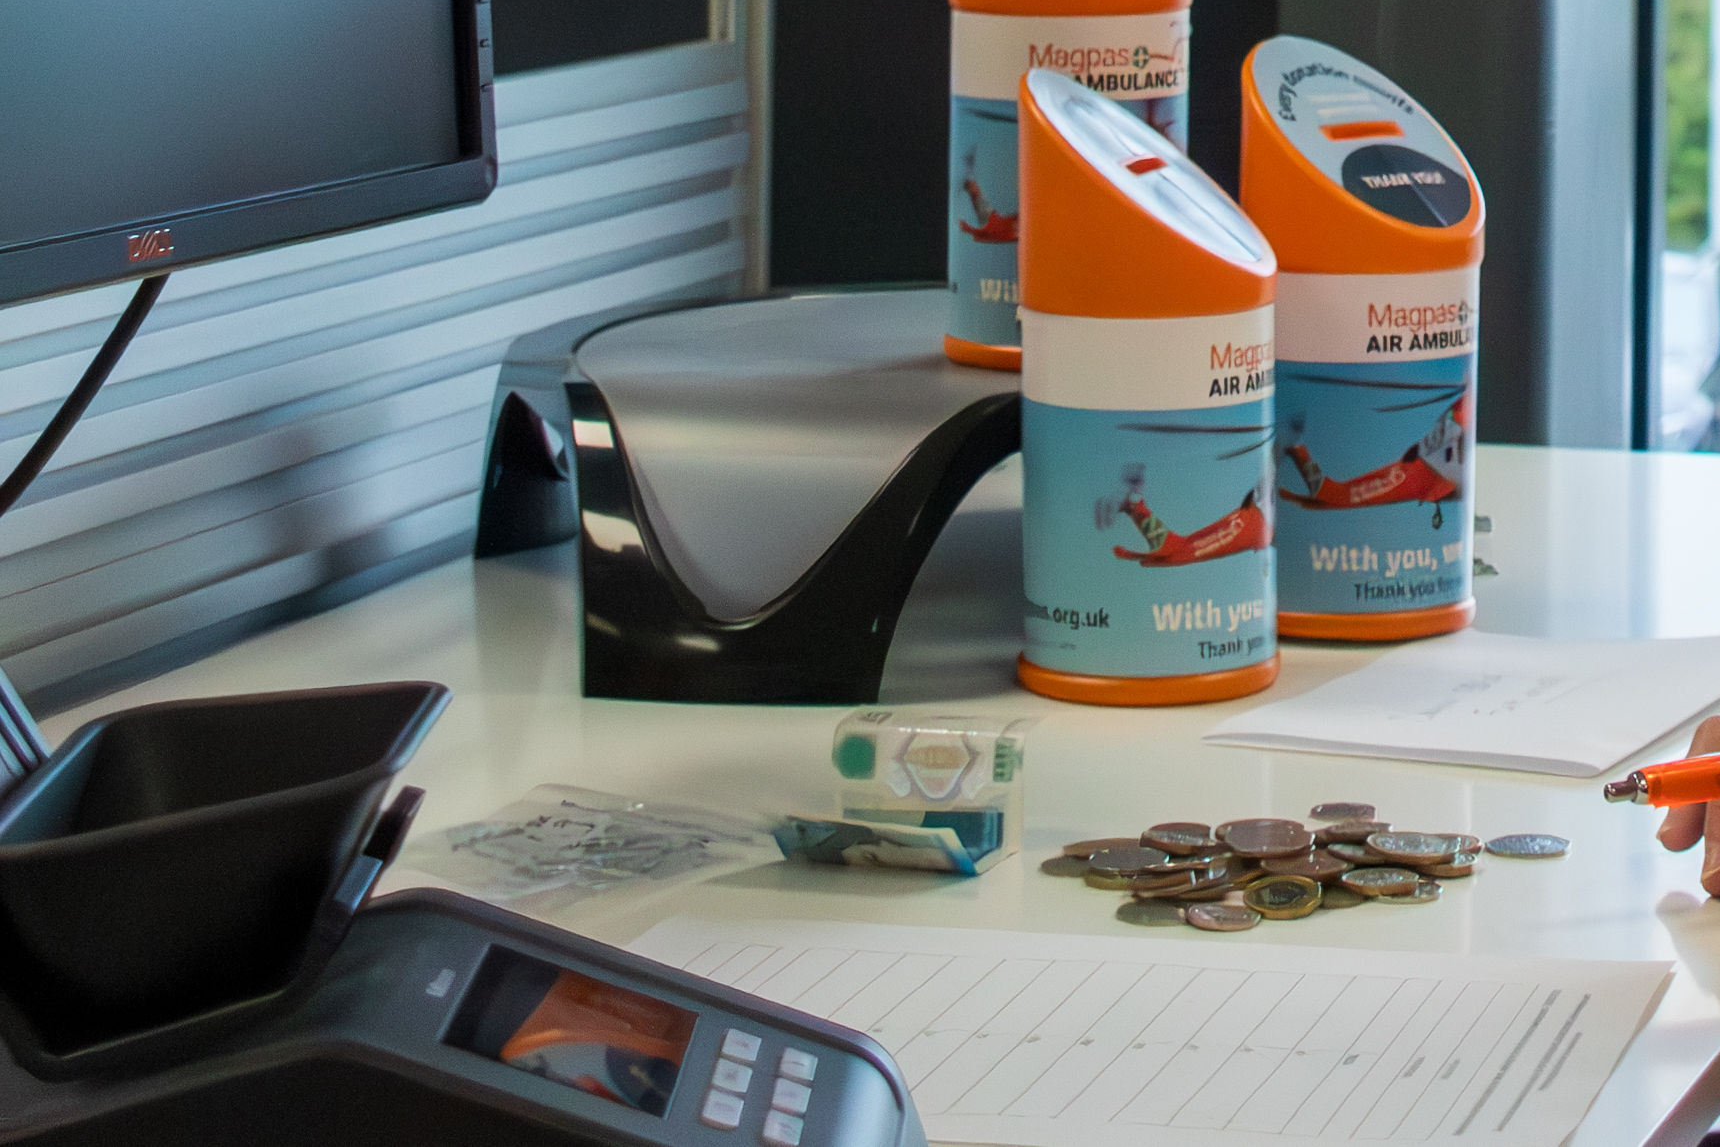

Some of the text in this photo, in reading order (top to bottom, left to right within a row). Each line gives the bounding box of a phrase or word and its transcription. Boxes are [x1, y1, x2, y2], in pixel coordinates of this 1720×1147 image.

[1028, 42, 1130, 74] Magpas
[1367, 302, 1457, 334] Magpas
[1366, 335, 1402, 353] AIR
[1208, 375, 1241, 398] AIR
[1310, 543, 1379, 572] With
[1384, 547, 1438, 578] you,
[1152, 598, 1221, 632] With
[1197, 636, 1243, 659] Thank
